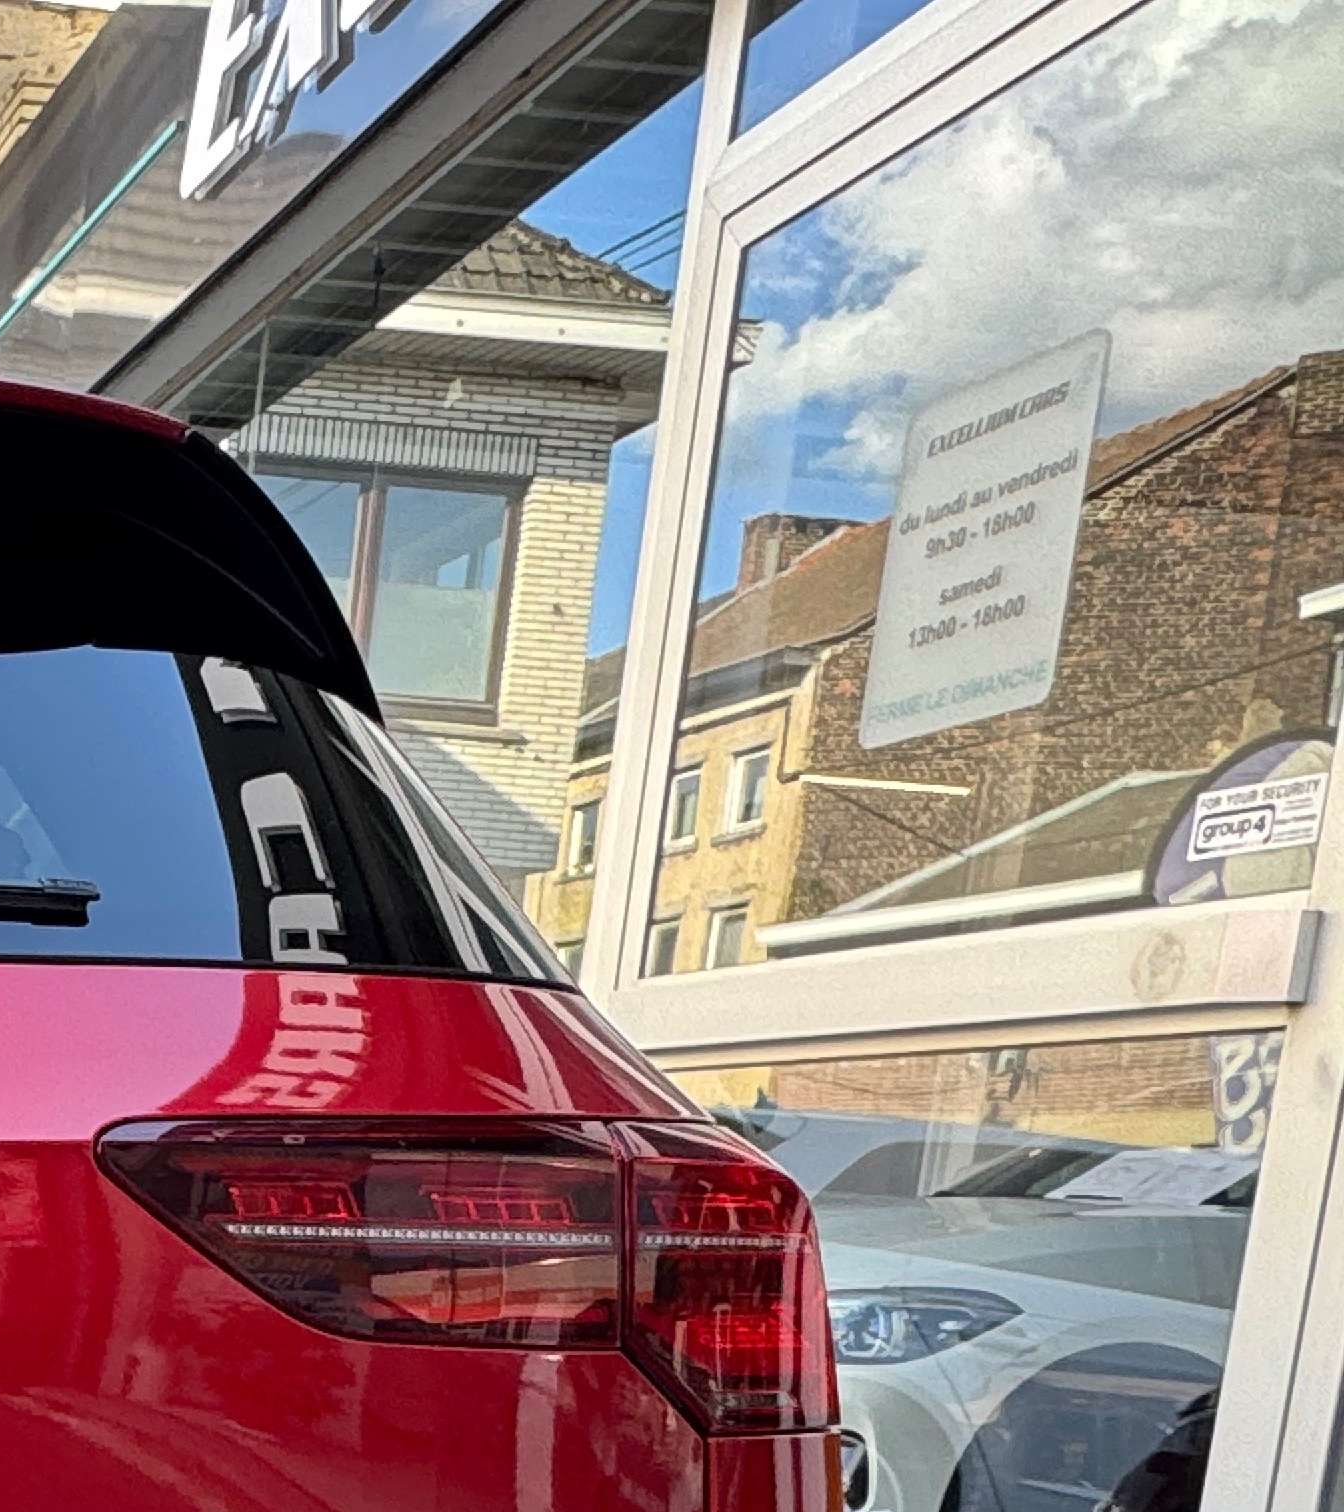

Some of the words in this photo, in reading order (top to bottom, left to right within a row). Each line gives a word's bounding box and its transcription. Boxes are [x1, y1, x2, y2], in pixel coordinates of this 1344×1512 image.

[1018, 379, 1072, 421] CARS
[898, 512, 921, 536] du
[925, 490, 968, 525] lundi
[998, 447, 1080, 498] vendredi
[938, 564, 1004, 606] samedi
